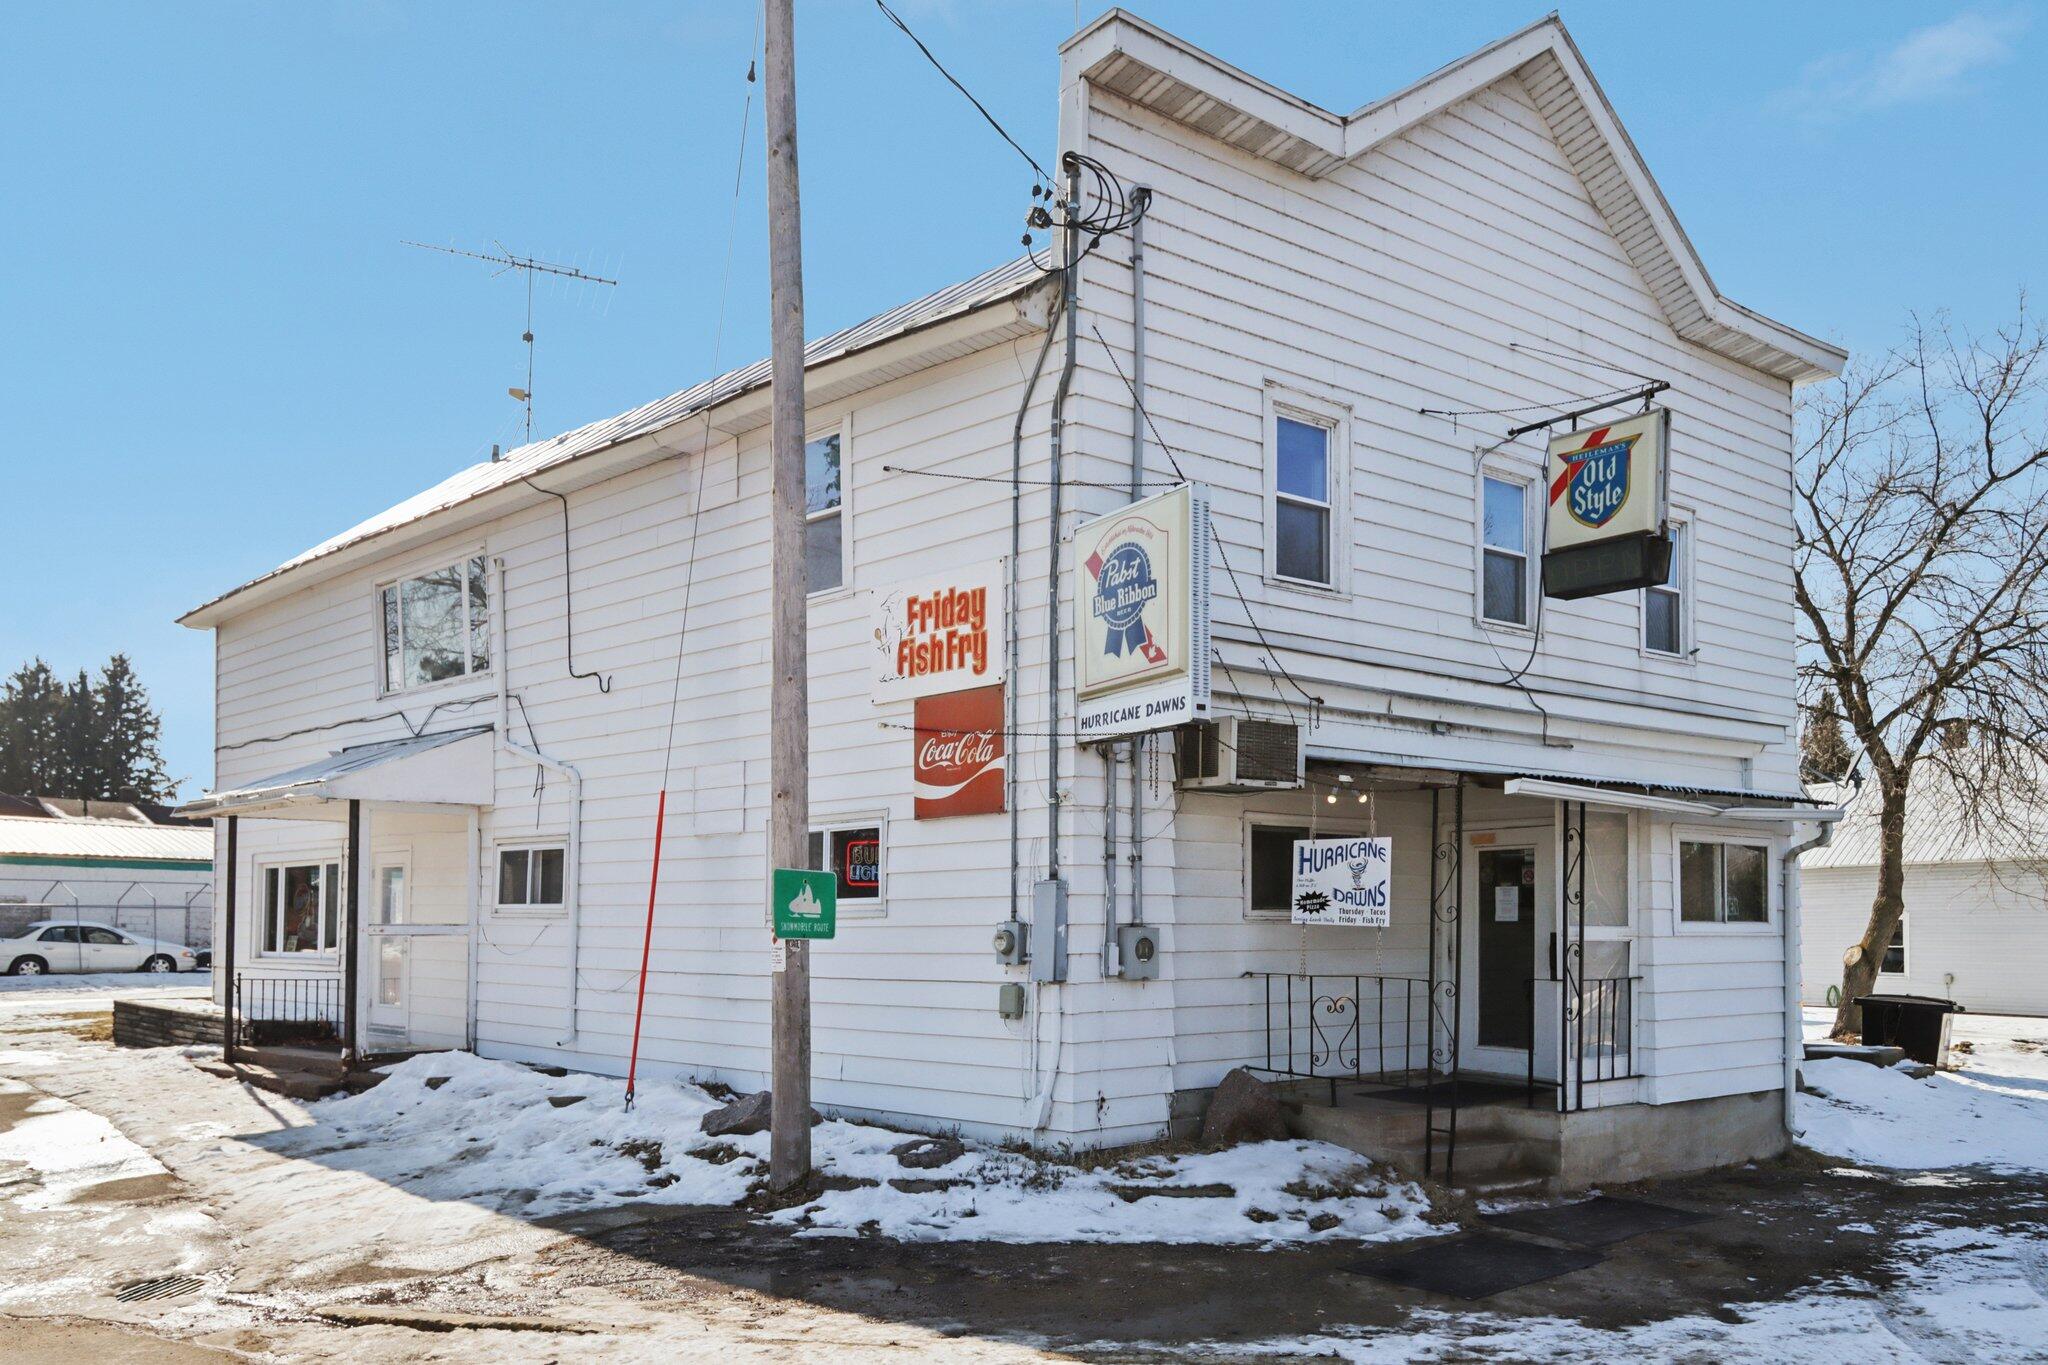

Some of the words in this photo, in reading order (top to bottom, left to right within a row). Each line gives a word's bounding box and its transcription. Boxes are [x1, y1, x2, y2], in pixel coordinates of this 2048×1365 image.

[1572, 443, 1626, 462] HEILEMAN'S
[1583, 454, 1617, 487] Old
[1574, 485, 1622, 519] Style
[1104, 556, 1141, 588] Pabst
[907, 585, 987, 635] Friday
[1094, 595, 1117, 616] Blue
[1118, 584, 1156, 607] Ribbon
[897, 633, 944, 678] Fish
[946, 629, 988, 677] Fry
[1081, 705, 1141, 730] HURRICANE
[1146, 696, 1186, 718] DAWNS
[919, 729, 996, 770] Coca-Cola
[1298, 841, 1386, 875] HURRICANE
[1333, 880, 1386, 907] DAWNS
[781, 922, 811, 932] SNOWMOBILE
[814, 923, 829, 932] ROUTE
[1339, 908, 1364, 916] Thursday
[1339, 916, 1356, 924] Friday
[1375, 917, 1385, 925] Fry
